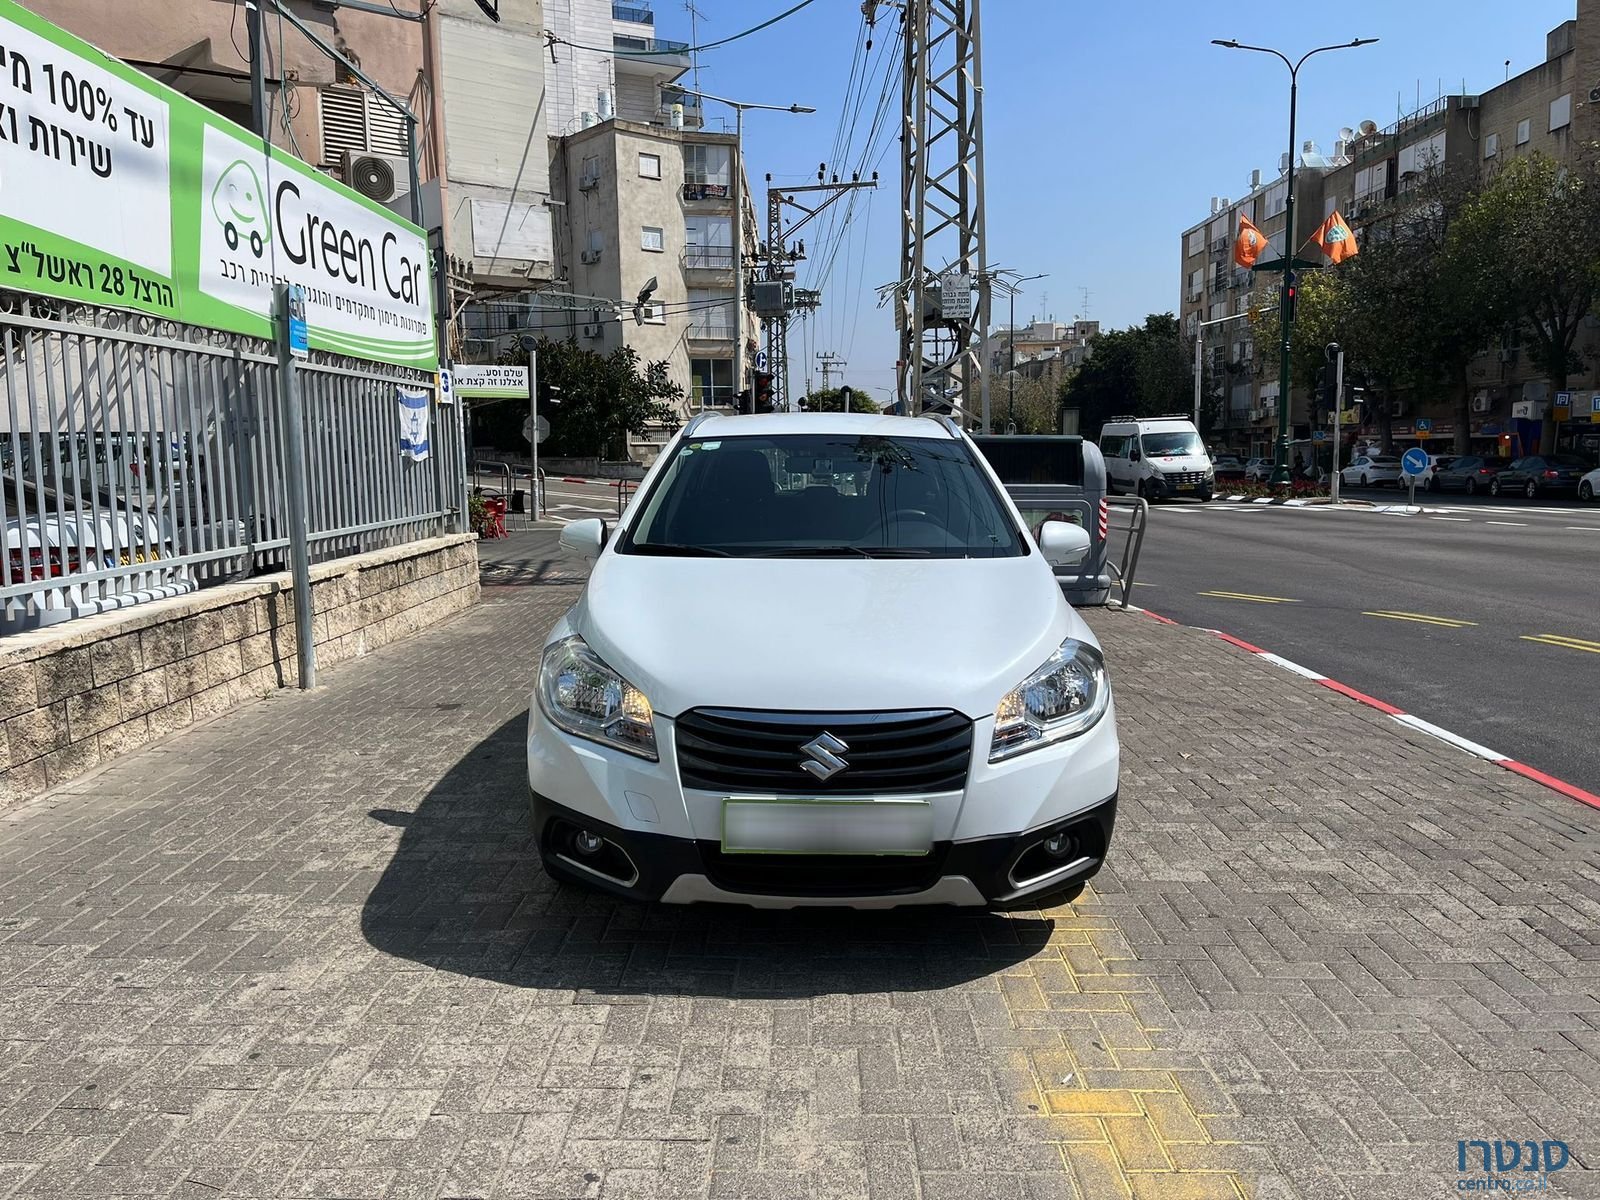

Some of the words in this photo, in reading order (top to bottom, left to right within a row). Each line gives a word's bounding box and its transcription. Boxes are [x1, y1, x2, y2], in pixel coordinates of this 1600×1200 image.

[43, 64, 117, 132] 100%
[124, 107, 154, 149] עד
[28, 114, 112, 178] שירות
[275, 180, 377, 291] Green
[381, 231, 421, 307] Car
[100, 263, 125, 296] 28
[220, 259, 246, 282] רכב
[129, 269, 173, 308] הרצל
[335, 295, 376, 320] מתקדמים
[378, 309, 398, 326] מימון
[400, 316, 427, 335] פתרונות
[466, 378, 485, 388] קצת
[487, 378, 497, 386] זה
[499, 377, 523, 386] אצלנו
[503, 368, 523, 377] שלם
